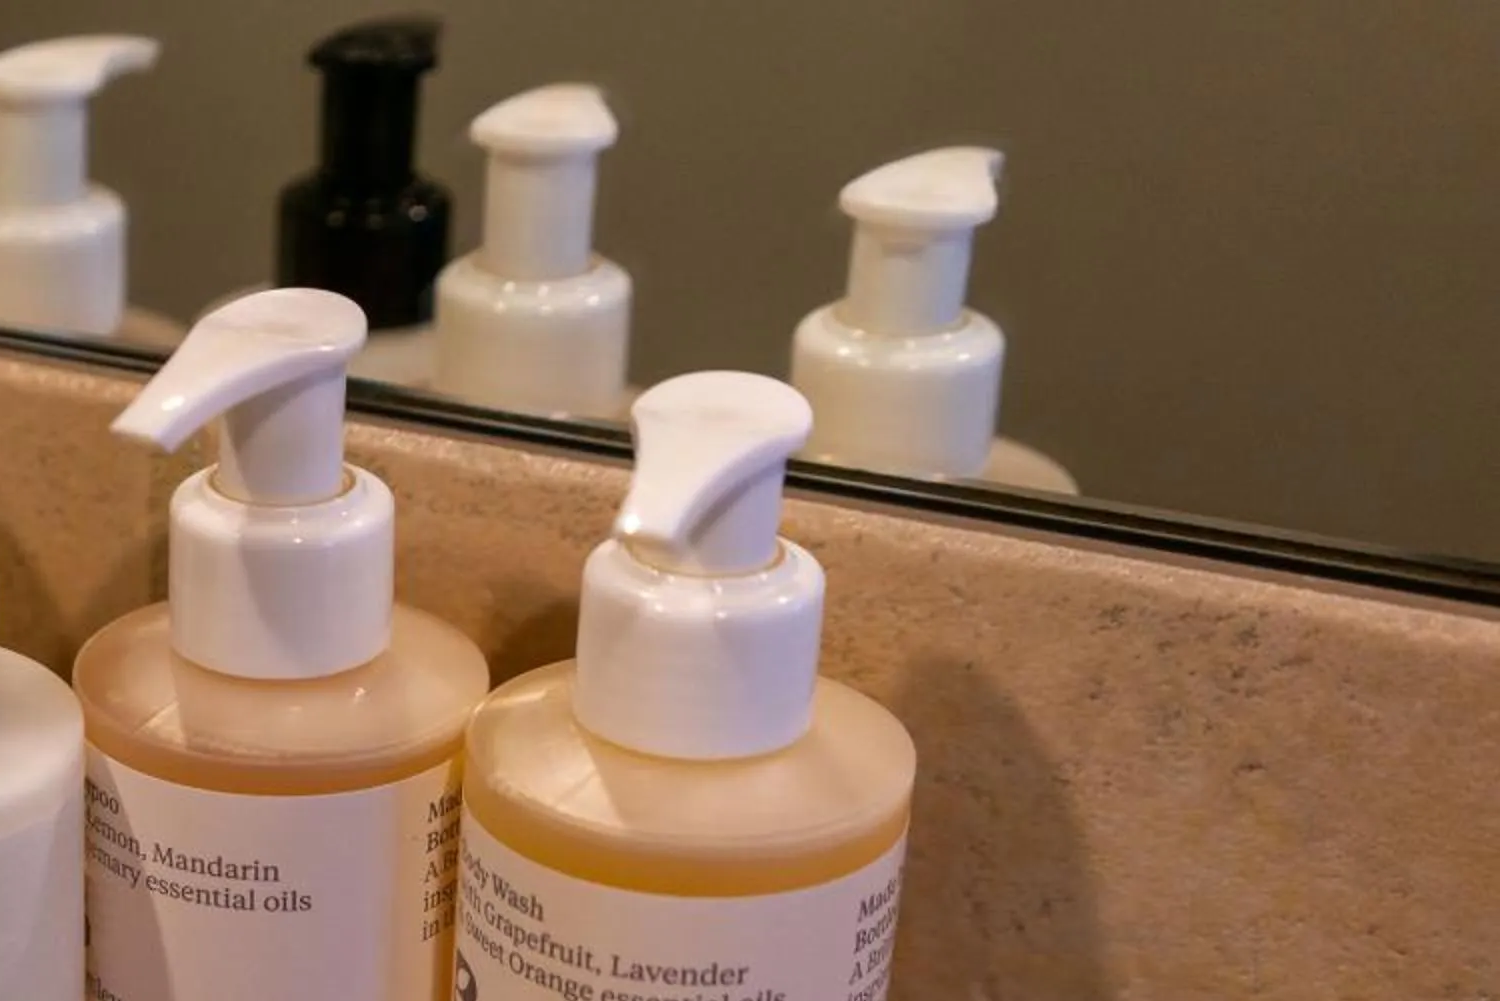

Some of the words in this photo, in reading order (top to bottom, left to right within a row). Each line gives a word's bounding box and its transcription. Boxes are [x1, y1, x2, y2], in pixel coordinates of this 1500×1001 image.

[152, 843, 280, 882] Mandarin
[145, 873, 255, 911] essential
[263, 890, 312, 912] oils
[492, 873, 545, 922] Wash
[465, 911, 504, 965] Sweet
[483, 901, 601, 975] Grapefruit,
[611, 954, 750, 987] Lavender
